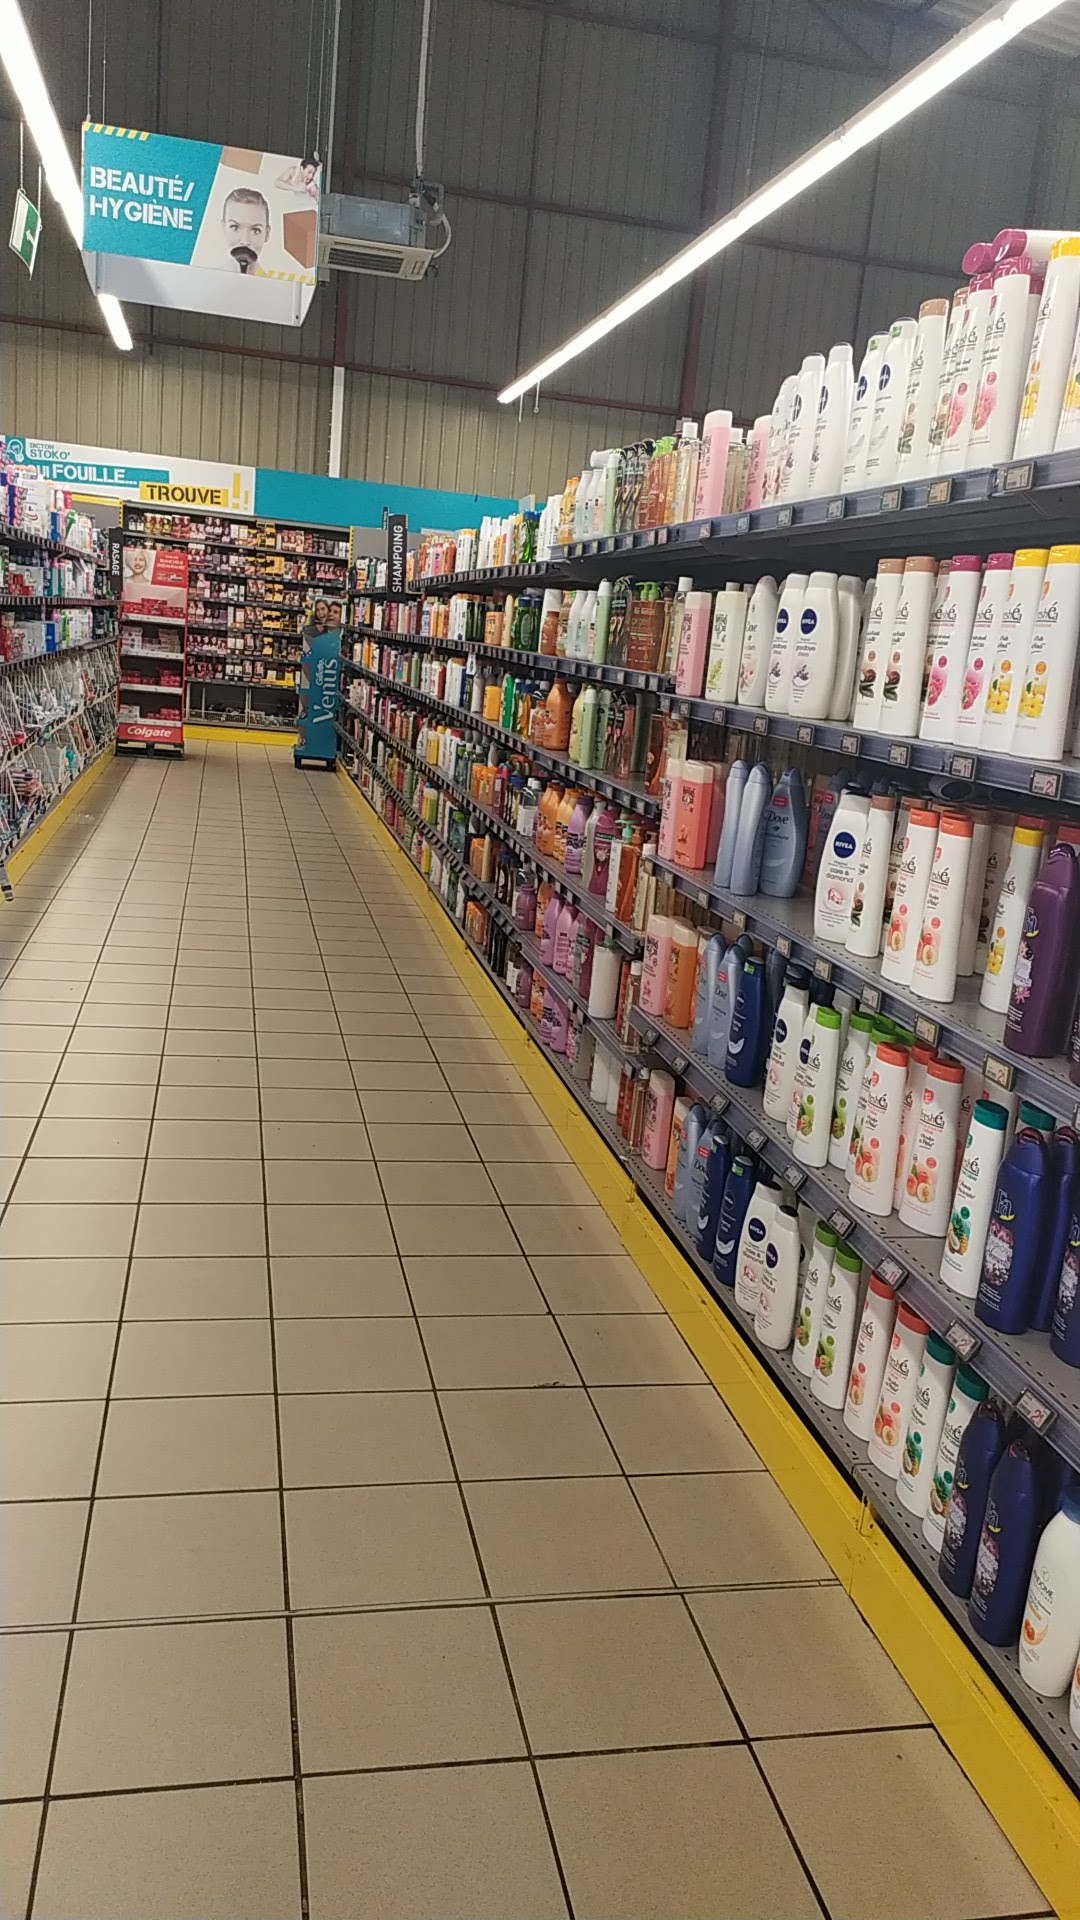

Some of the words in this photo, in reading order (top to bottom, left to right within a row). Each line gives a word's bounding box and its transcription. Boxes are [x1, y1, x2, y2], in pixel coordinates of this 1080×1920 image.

[90, 166, 195, 202] BEAUTÉ/
[89, 195, 193, 231] HYGIÈNE
[30, 442, 54, 450] DICTON
[30, 449, 70, 460] STOKO'
[146, 484, 222, 506] TROUVE
[111, 542, 120, 576] RASAGE
[392, 524, 404, 593] SHAMPOING
[313, 658, 338, 723] Venus
[127, 726, 172, 739] Colgate
[768, 811, 789, 825] Dove
[835, 841, 853, 850] NIVEA
[826, 872, 854, 883] diamond
[830, 867, 843, 875] care
[995, 1188, 1012, 1217] Fa
